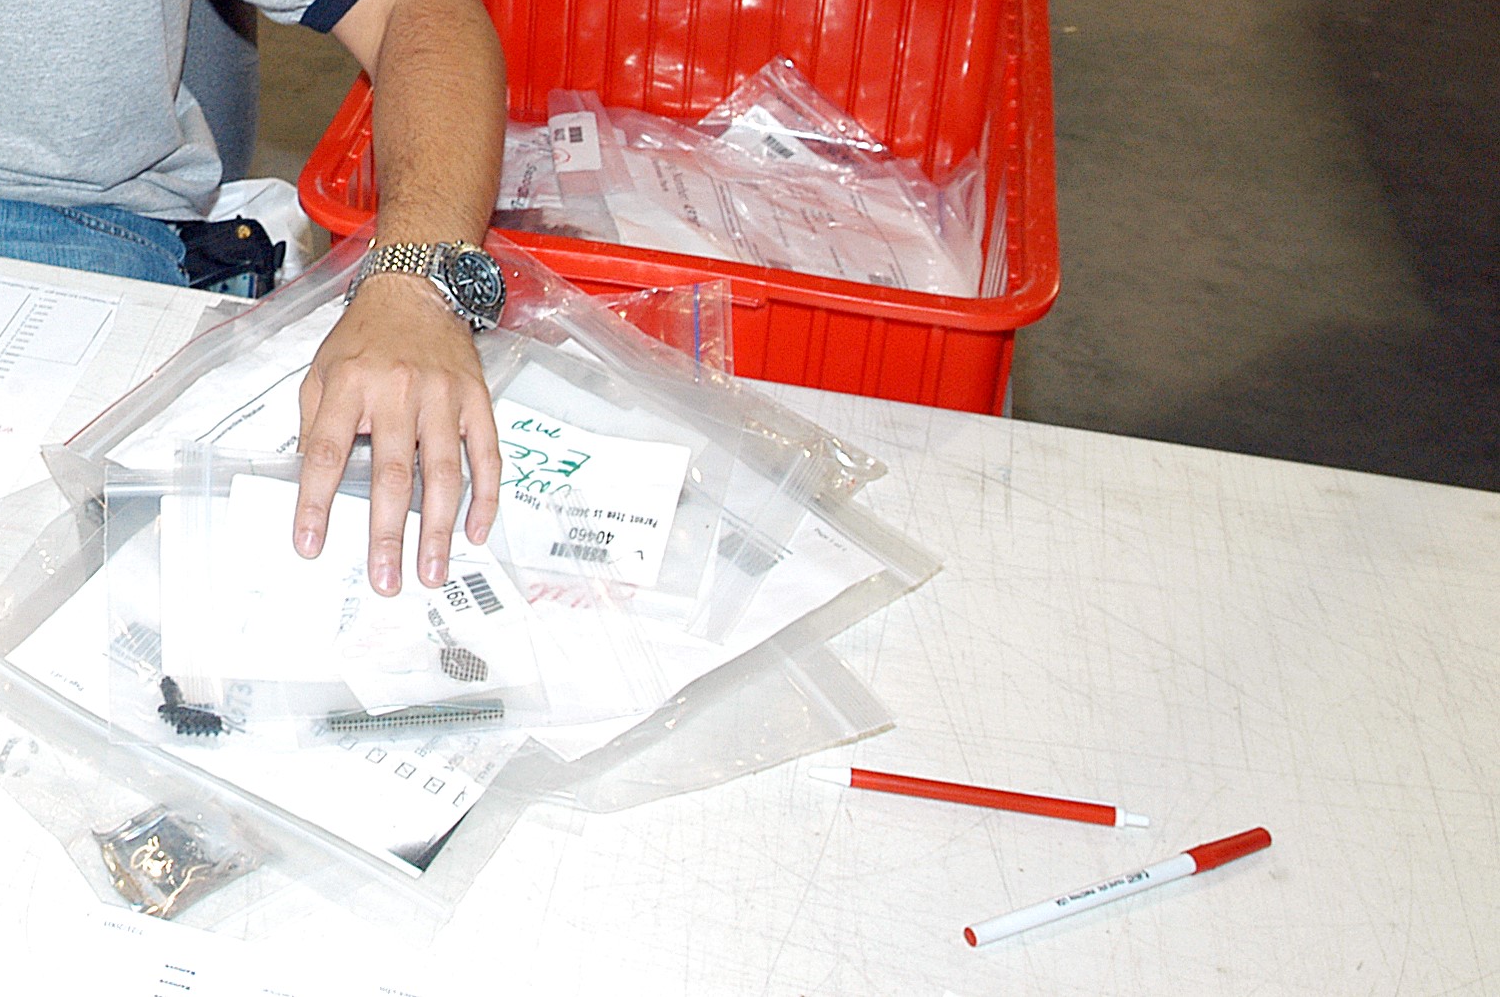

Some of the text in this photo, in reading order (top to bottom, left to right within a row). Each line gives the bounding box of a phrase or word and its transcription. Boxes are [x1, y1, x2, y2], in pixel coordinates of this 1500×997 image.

[513, 490, 542, 511] Pieces
[592, 508, 604, 519] is
[606, 510, 627, 523] Item
[629, 513, 658, 529] Parent
[569, 525, 615, 546] 40460
